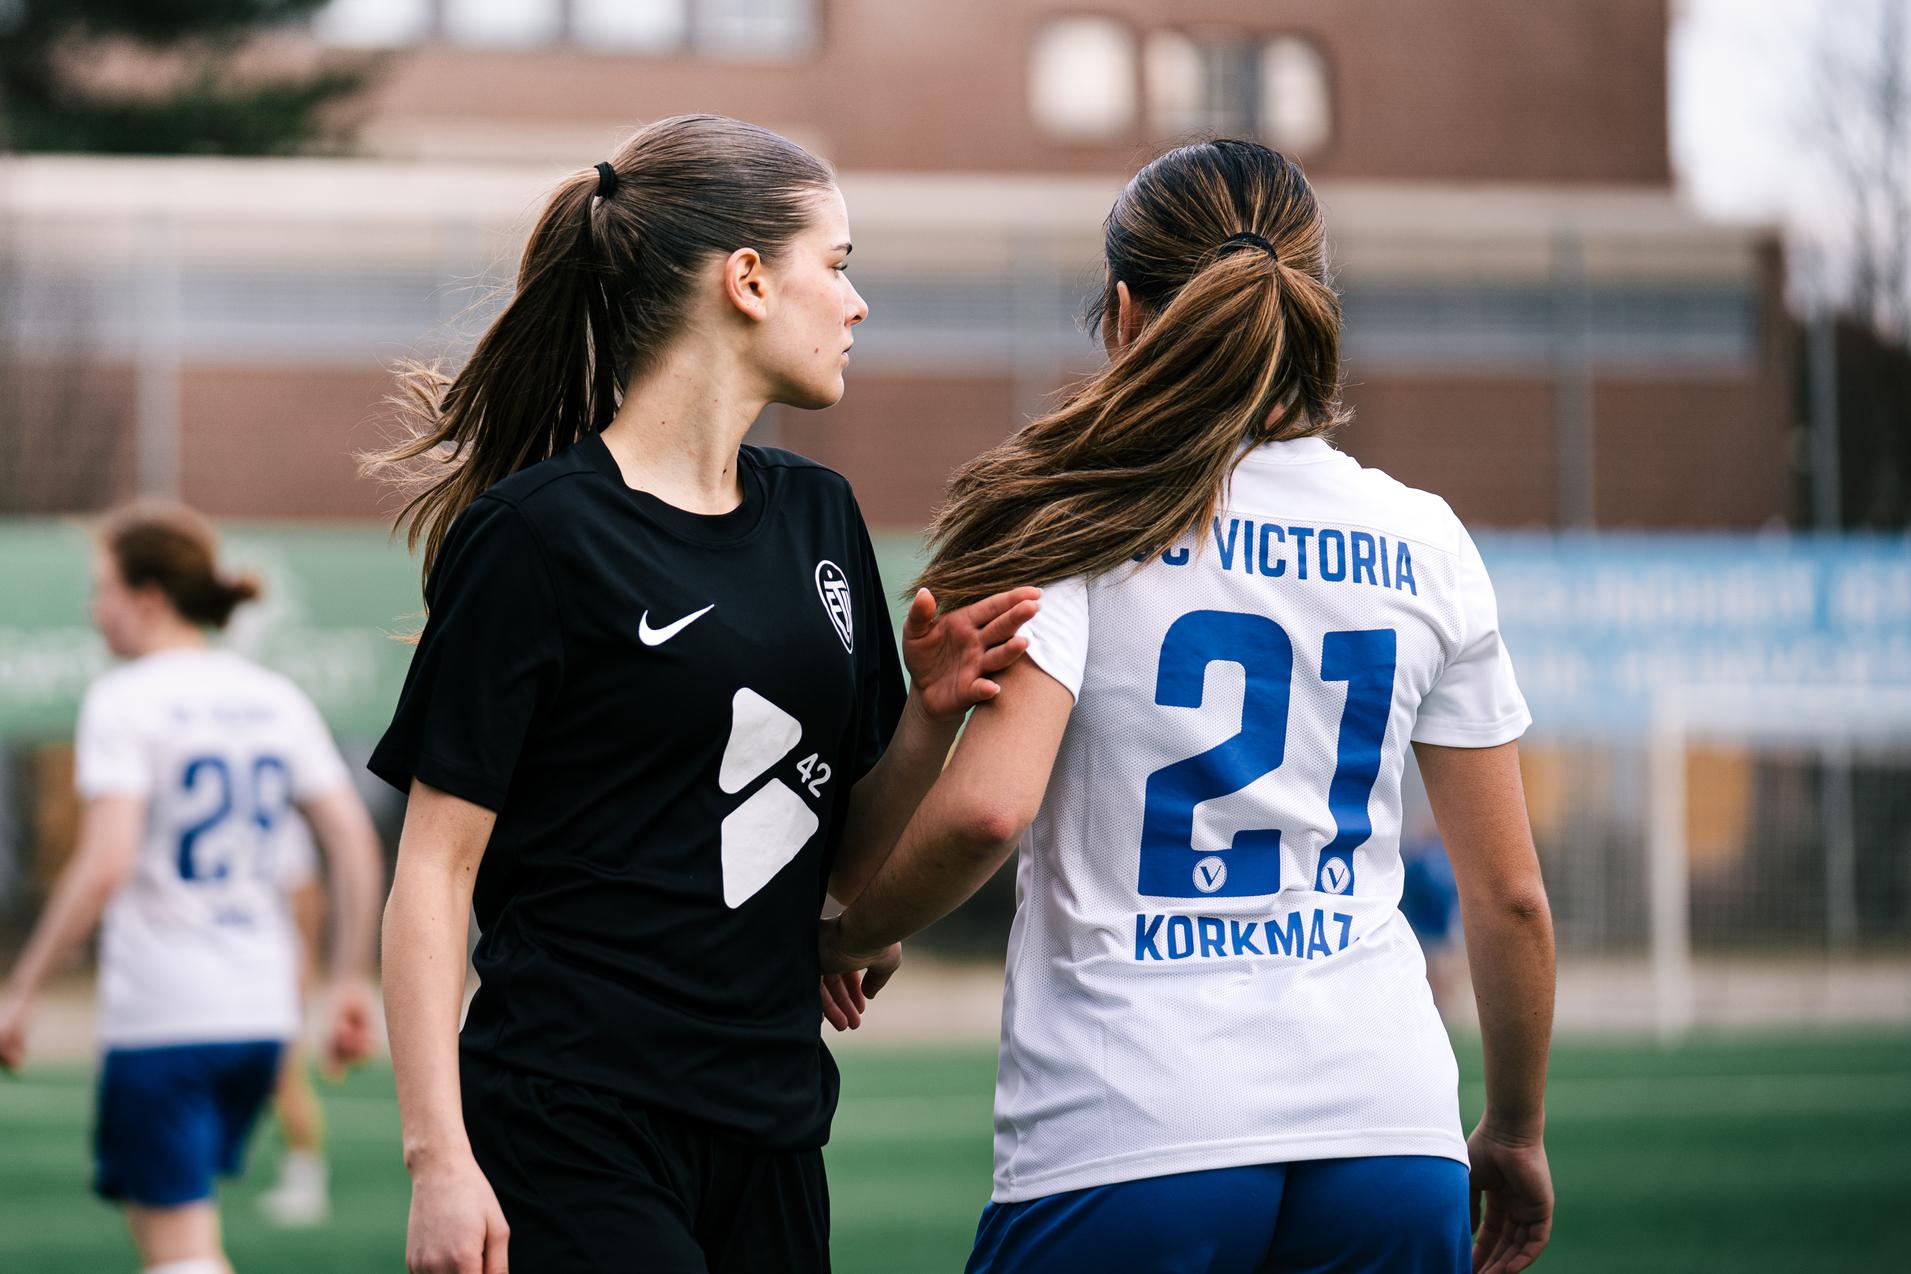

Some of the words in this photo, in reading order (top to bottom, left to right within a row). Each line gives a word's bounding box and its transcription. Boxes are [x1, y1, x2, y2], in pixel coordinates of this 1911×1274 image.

[1213, 516, 1417, 595] VICTORIA
[796, 753, 832, 798] 42
[1138, 610, 1396, 898] 21
